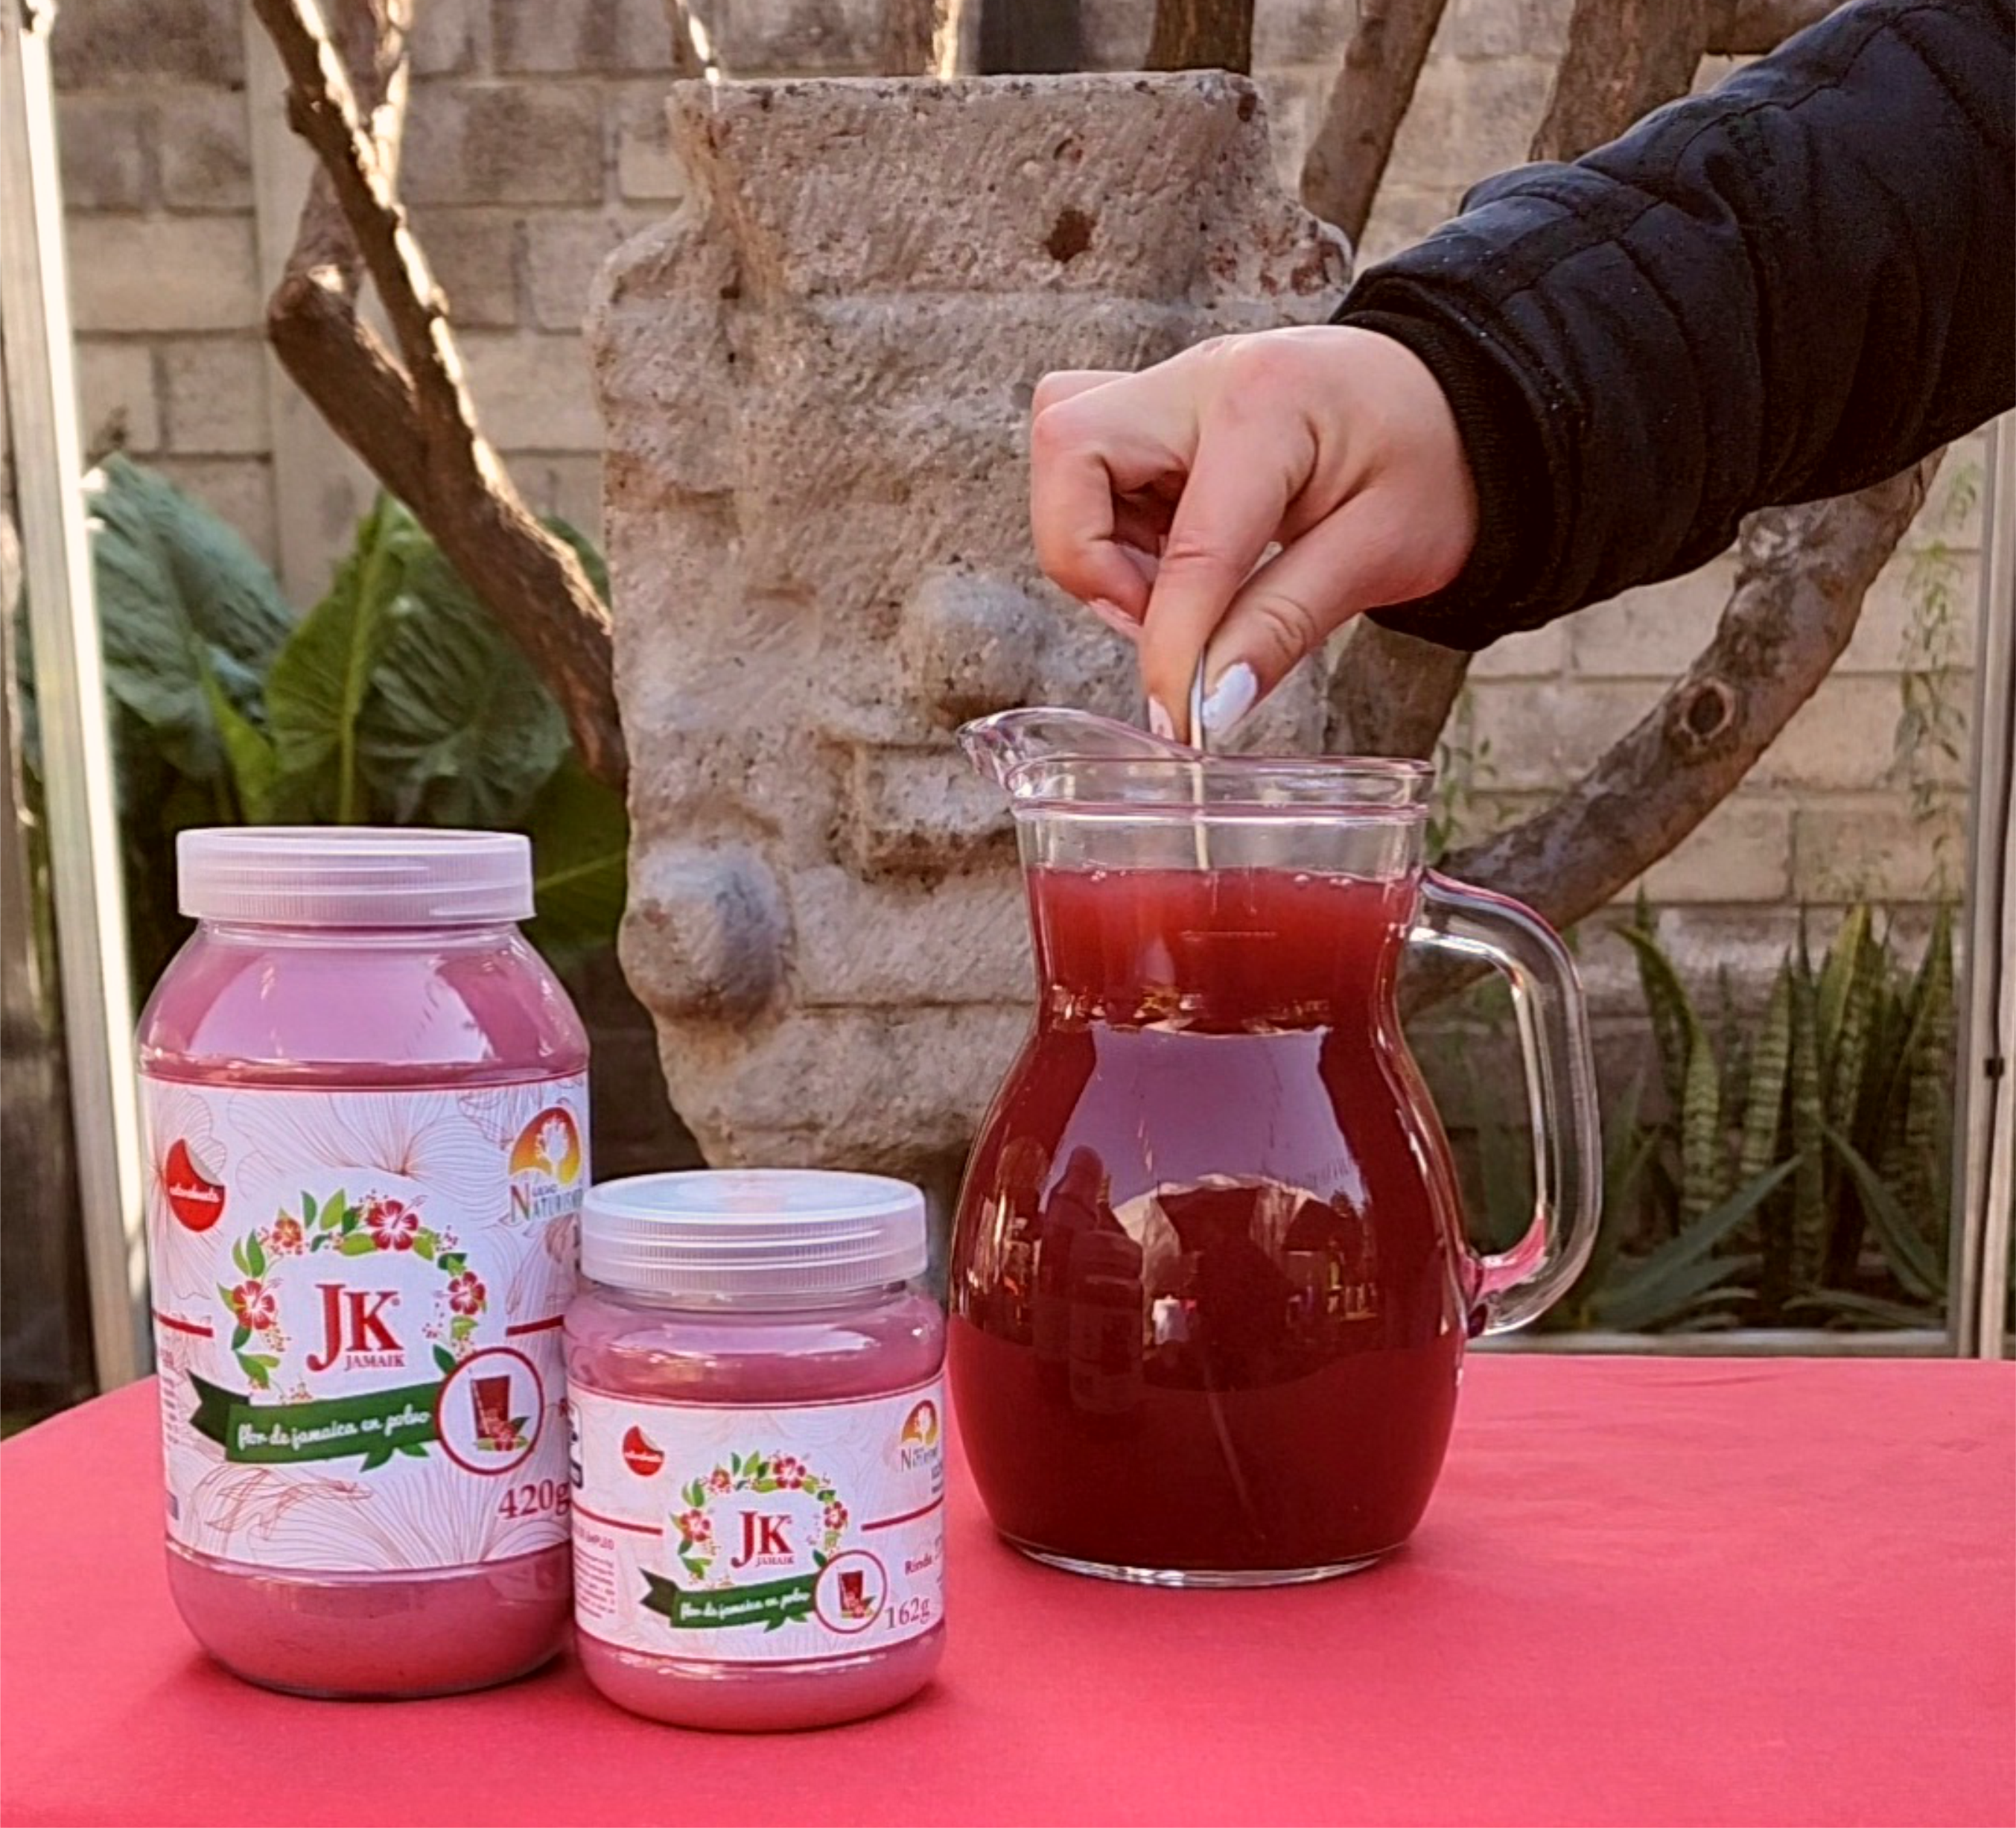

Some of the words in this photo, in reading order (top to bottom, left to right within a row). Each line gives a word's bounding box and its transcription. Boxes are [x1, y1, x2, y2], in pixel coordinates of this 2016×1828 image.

[306, 1283, 404, 1372] JK
[343, 1354, 406, 1372] JAMAIK
[238, 1423, 267, 1451] flor
[269, 1423, 290, 1446] de
[290, 1420, 358, 1451] jamaica
[360, 1418, 383, 1432] en
[384, 1403, 432, 1437] polvo
[497, 1479, 571, 1519] 420g
[731, 1510, 795, 1569] JK
[885, 1596, 931, 1631] 162g
